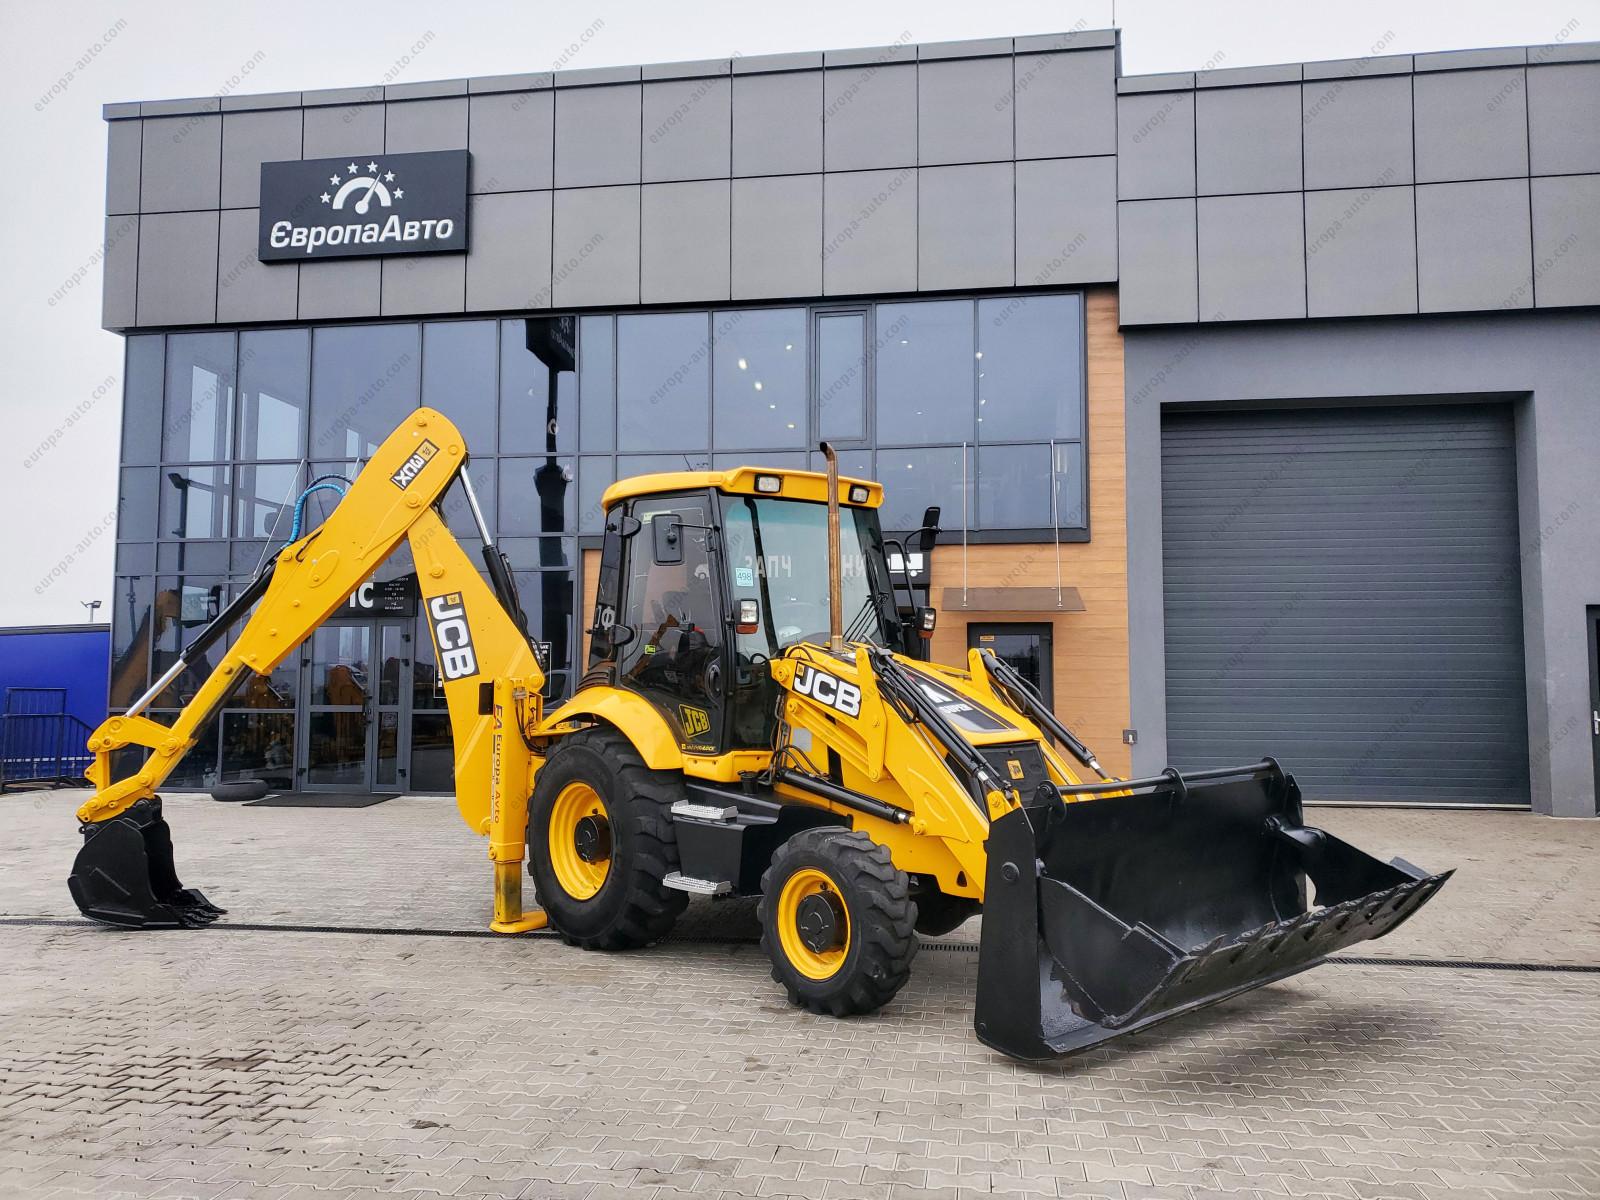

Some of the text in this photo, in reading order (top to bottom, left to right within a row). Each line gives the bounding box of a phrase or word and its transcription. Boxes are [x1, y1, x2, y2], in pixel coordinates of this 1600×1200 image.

[270, 215, 454, 253] ЄвропаАвто
[737, 572, 752, 582] 498
[431, 597, 475, 679] JCB
[794, 667, 861, 716] JCB
[684, 708, 708, 735] JCB
[494, 734, 503, 785] Europa
[494, 791, 502, 824] Avto
